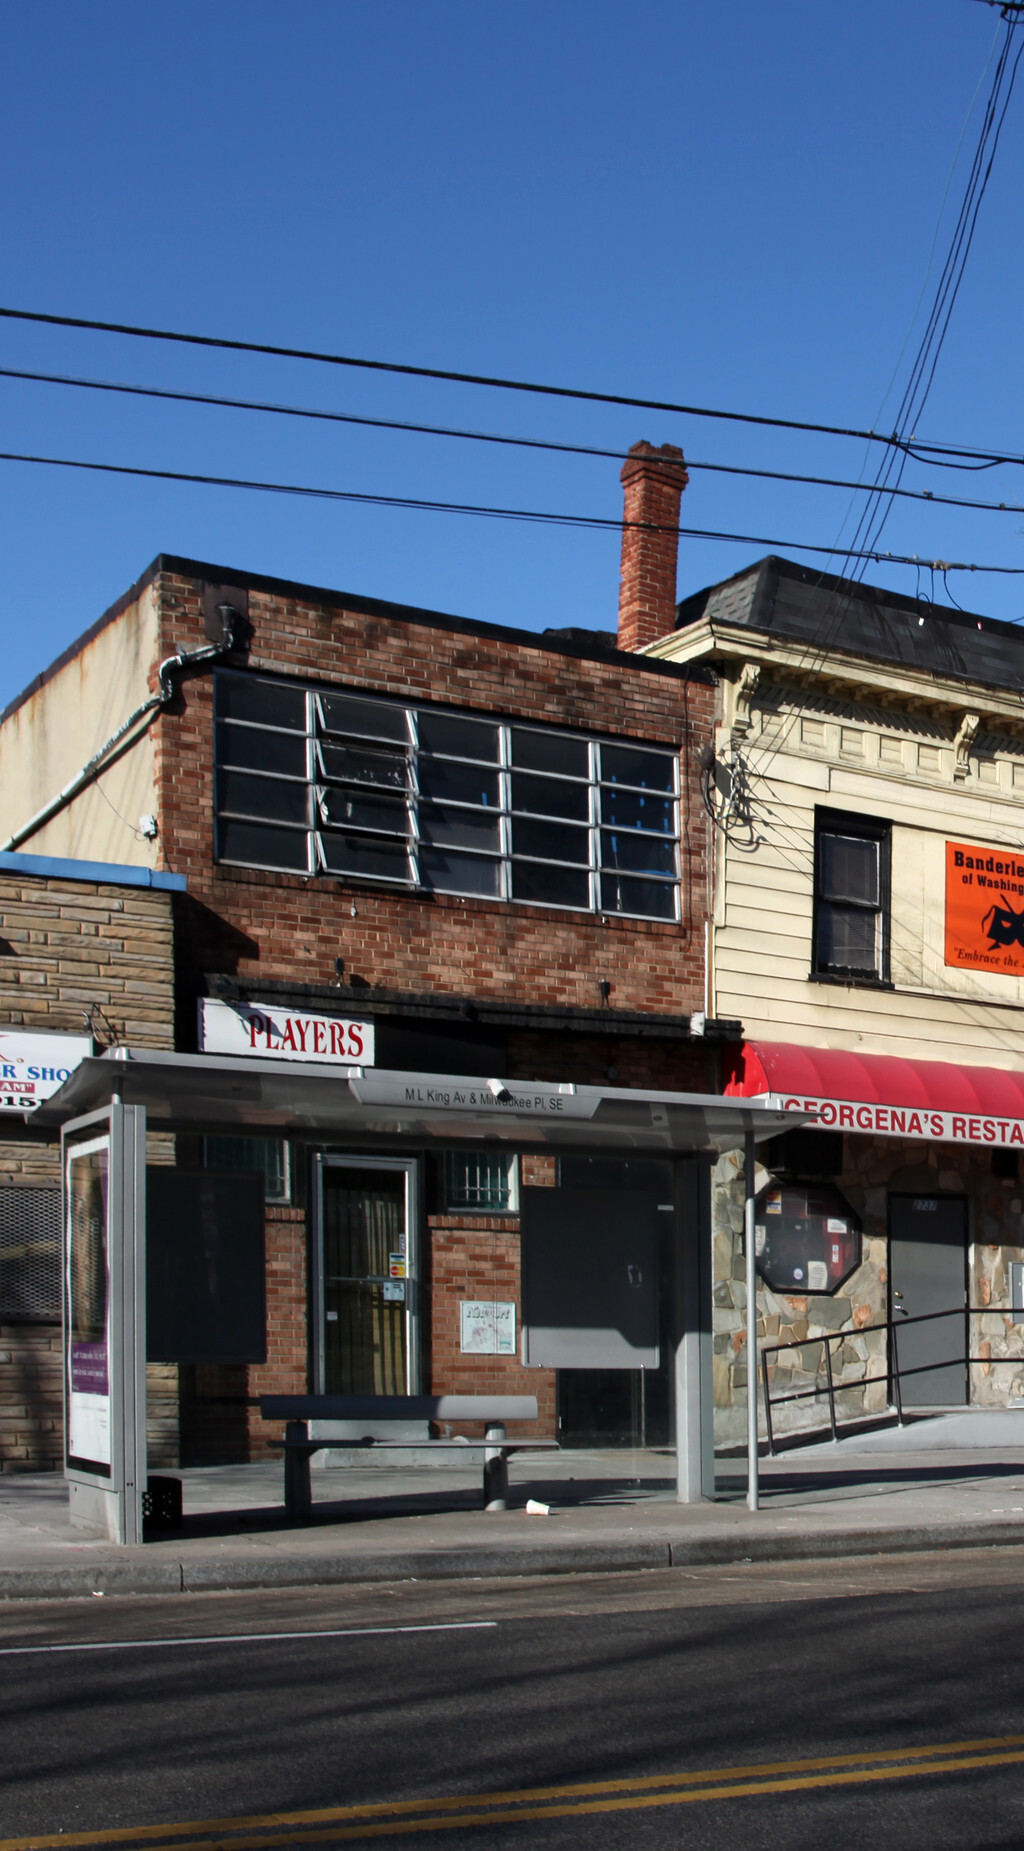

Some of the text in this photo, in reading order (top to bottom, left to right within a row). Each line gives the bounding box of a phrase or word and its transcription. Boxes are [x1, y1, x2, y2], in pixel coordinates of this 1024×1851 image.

[962, 873, 973, 884] of
[1003, 955, 1019, 967] the
[248, 1014, 364, 1057] PLAYERS
[0, 1064, 72, 1082] R SHO
[405, 1088, 415, 1101] M
[417, 1089, 424, 1101] L
[427, 1090, 450, 1106] King
[453, 1091, 466, 1104] Av
[469, 1092, 477, 1105] &
[549, 1098, 563, 1111] SE
